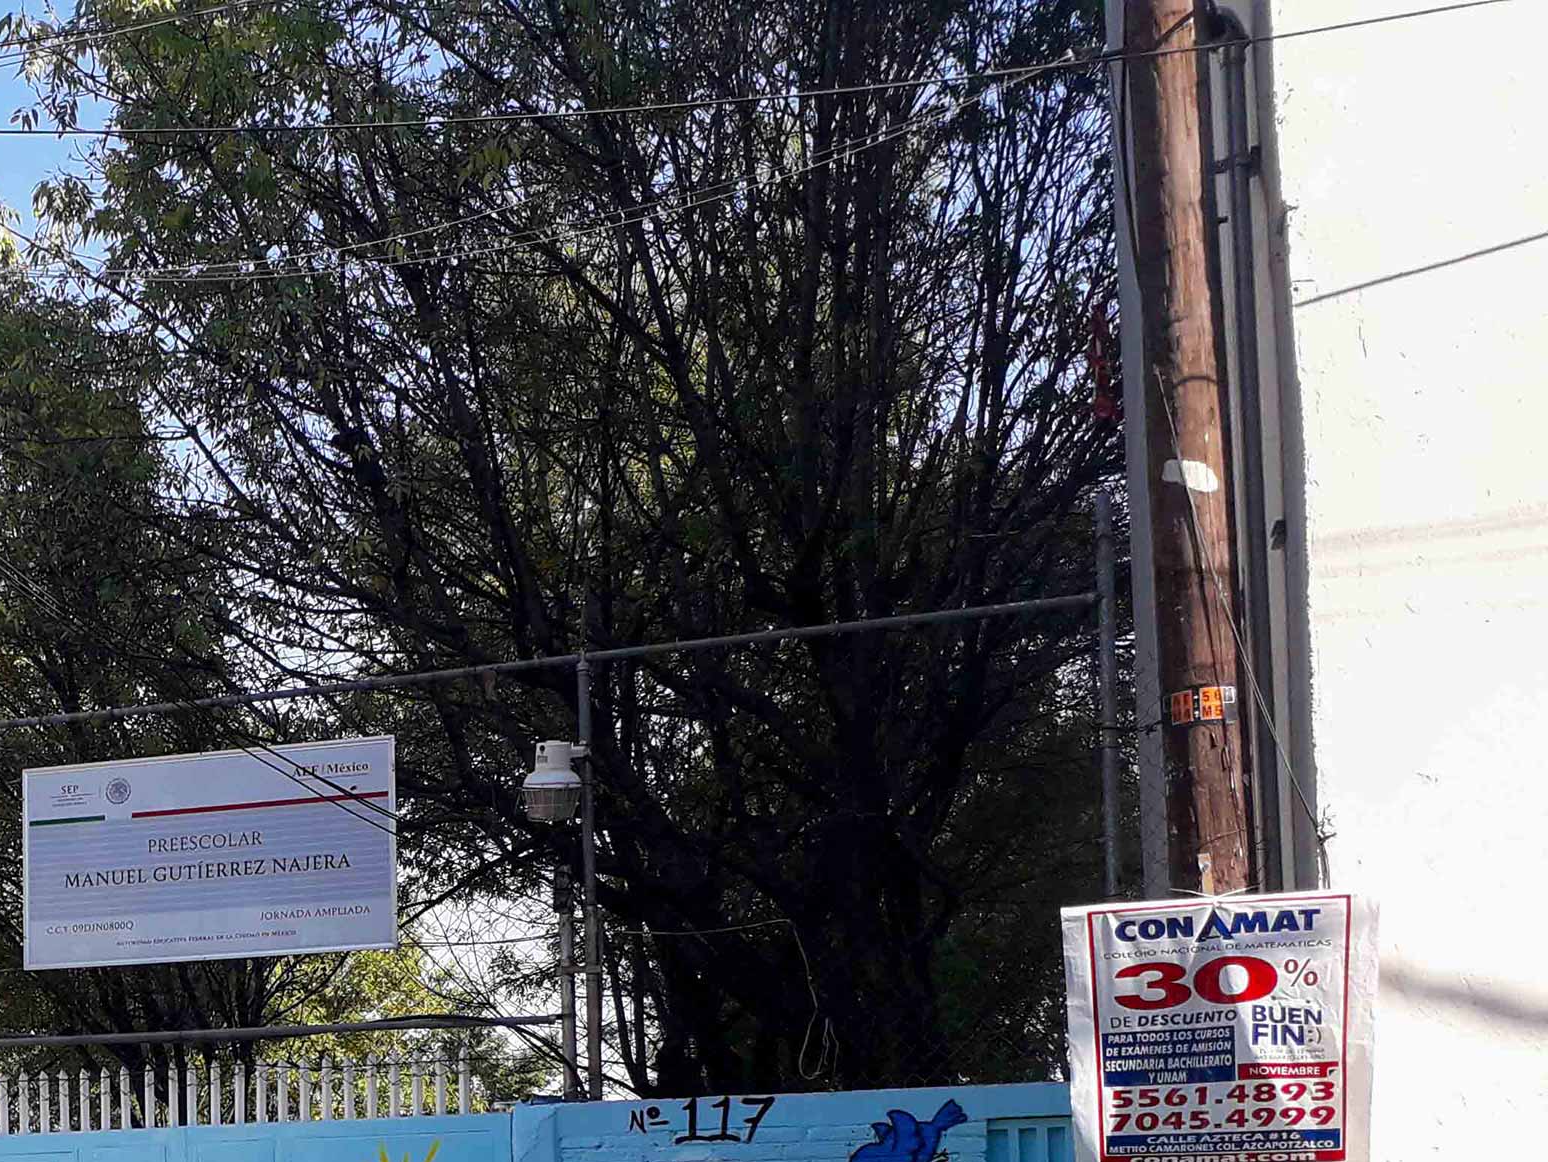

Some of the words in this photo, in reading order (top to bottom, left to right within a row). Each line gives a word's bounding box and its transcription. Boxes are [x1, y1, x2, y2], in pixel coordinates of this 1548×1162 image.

[148, 831, 263, 853] PREESCOLAR
[65, 869, 148, 889] MANUEL
[272, 852, 351, 873] NAJERA
[260, 909, 311, 921] JORNADA
[314, 905, 371, 918] AMPLIADA
[1115, 909, 1320, 942] CONAMAT
[1104, 950, 1156, 961] COLEGIO
[1161, 944, 1221, 956] NACIONAL
[1225, 943, 1241, 951] DE
[1110, 1016, 1131, 1028] DE
[1137, 1009, 1237, 1027] DESCUENTO
[1252, 1005, 1322, 1025] BUEN
[1108, 1033, 1133, 1044] PARA
[1135, 1032, 1171, 1042] TODOS
[1173, 1030, 1192, 1040] LOS
[1195, 1027, 1230, 1039] CURSOS
[1106, 1047, 1119, 1057] DE
[1175, 1044, 1188, 1053] DE
[1105, 1059, 1165, 1072] SECUNDARIA
[1168, 1055, 1232, 1069] BACHILLERATO
[1249, 1066, 1321, 1076] NOVIEMBRE
[1148, 1073, 1155, 1083] Y
[1157, 1071, 1187, 1083] UNAM
[1112, 1081, 1335, 1109] 5561.4893
[675, 1096, 775, 1144] 117
[1109, 1105, 1336, 1133] 7045.4999
[1109, 1145, 1146, 1154] METRO
[1149, 1143, 1214, 1152] CAMARONES
[1242, 1139, 1334, 1150] AZCAPOTZALCO
[1147, 1135, 1196, 1144] CALLE
[1200, 1133, 1264, 1142] AZTECA
